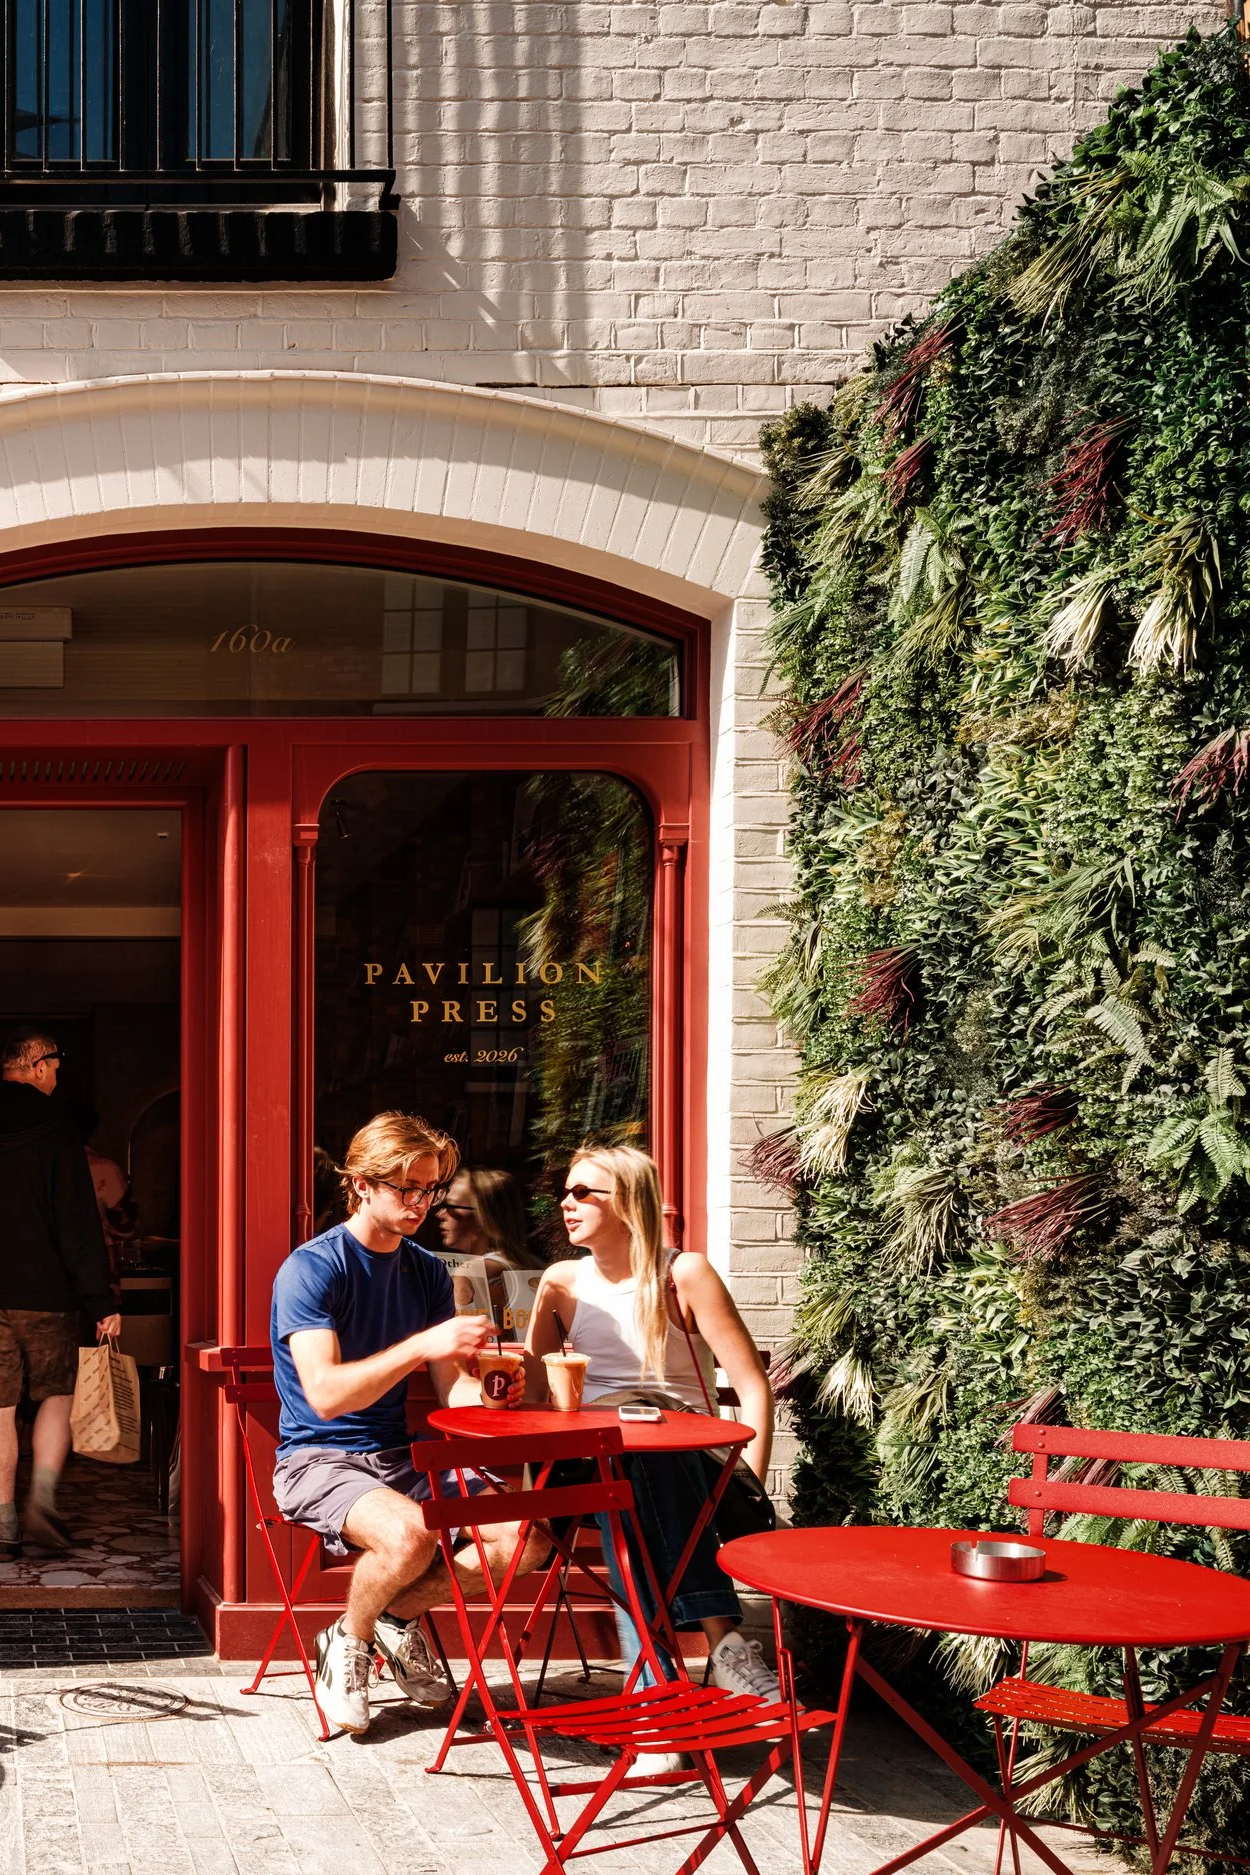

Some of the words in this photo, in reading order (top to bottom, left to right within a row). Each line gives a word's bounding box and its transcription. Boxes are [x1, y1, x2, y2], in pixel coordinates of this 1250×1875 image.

[210, 623, 296, 654] 160a
[364, 962, 604, 985] PAVILION
[410, 1000, 556, 1023] PRESS
[444, 1051, 469, 1063] est.
[473, 1046, 525, 1063] 2026
